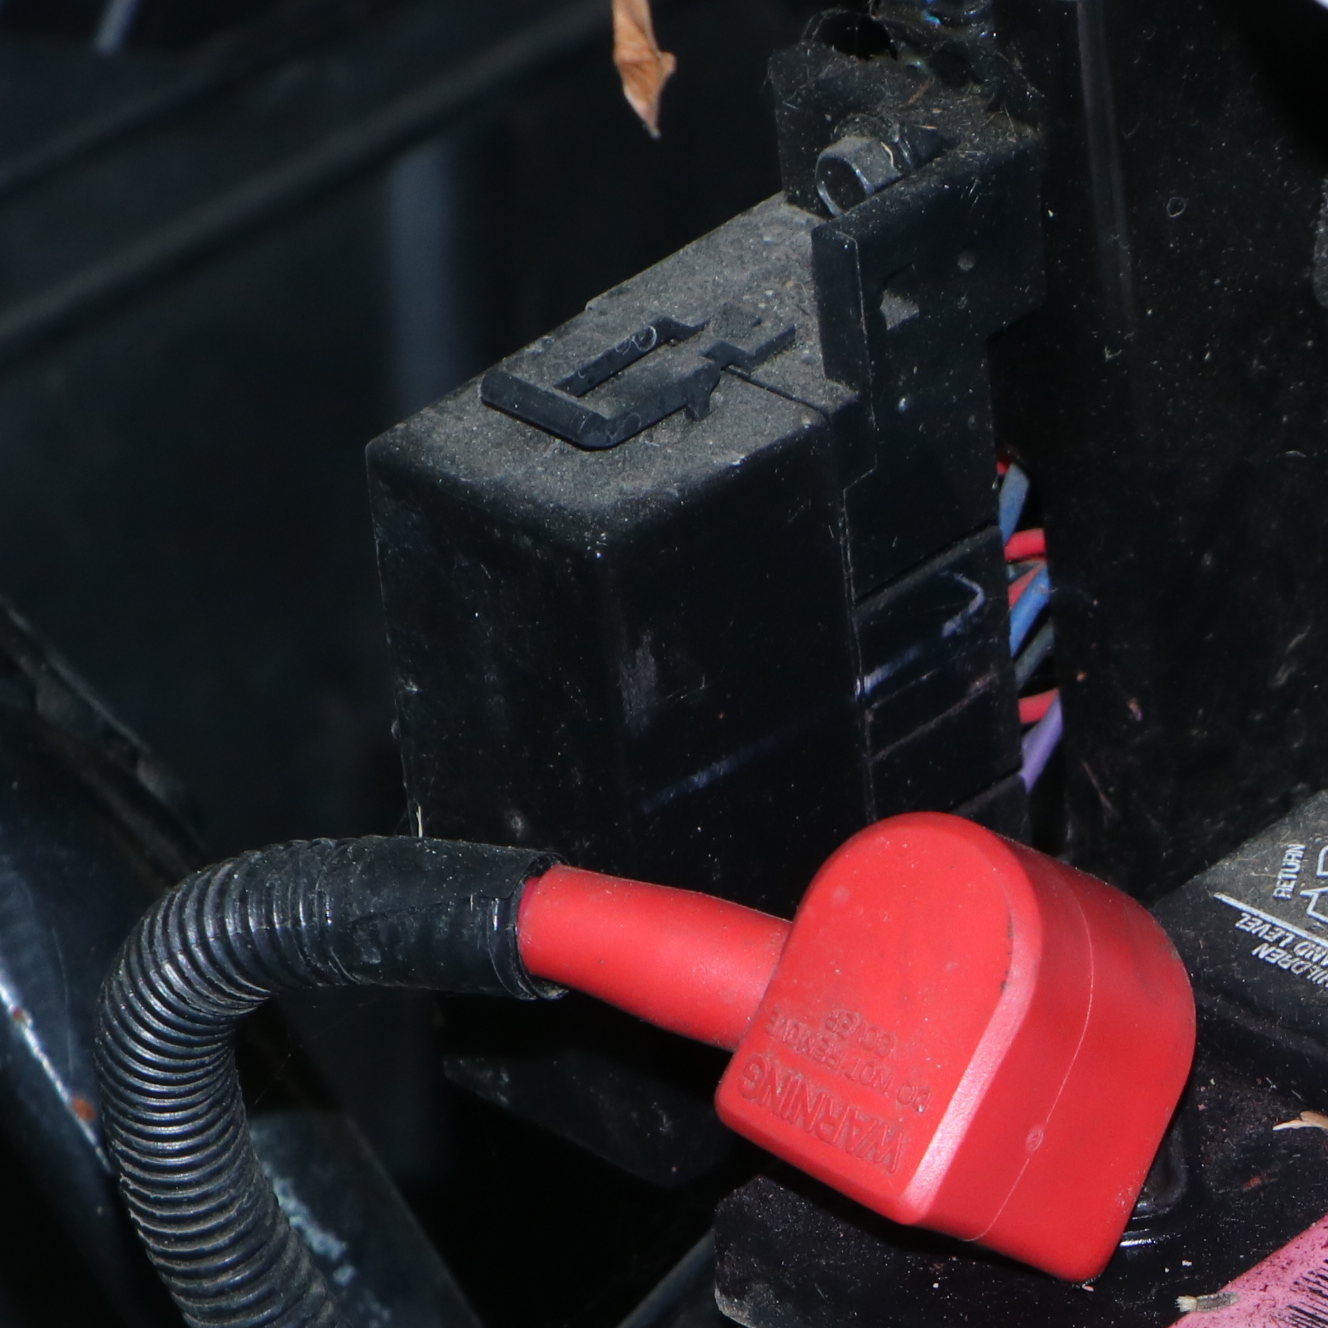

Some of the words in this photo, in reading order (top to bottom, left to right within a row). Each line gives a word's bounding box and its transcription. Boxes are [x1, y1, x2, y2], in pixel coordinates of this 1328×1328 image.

[1229, 913, 1298, 946] LEVEL
[764, 1007, 844, 1076] REMOVE
[824, 1009, 892, 1057] COVER
[738, 1052, 908, 1174] WARNING
